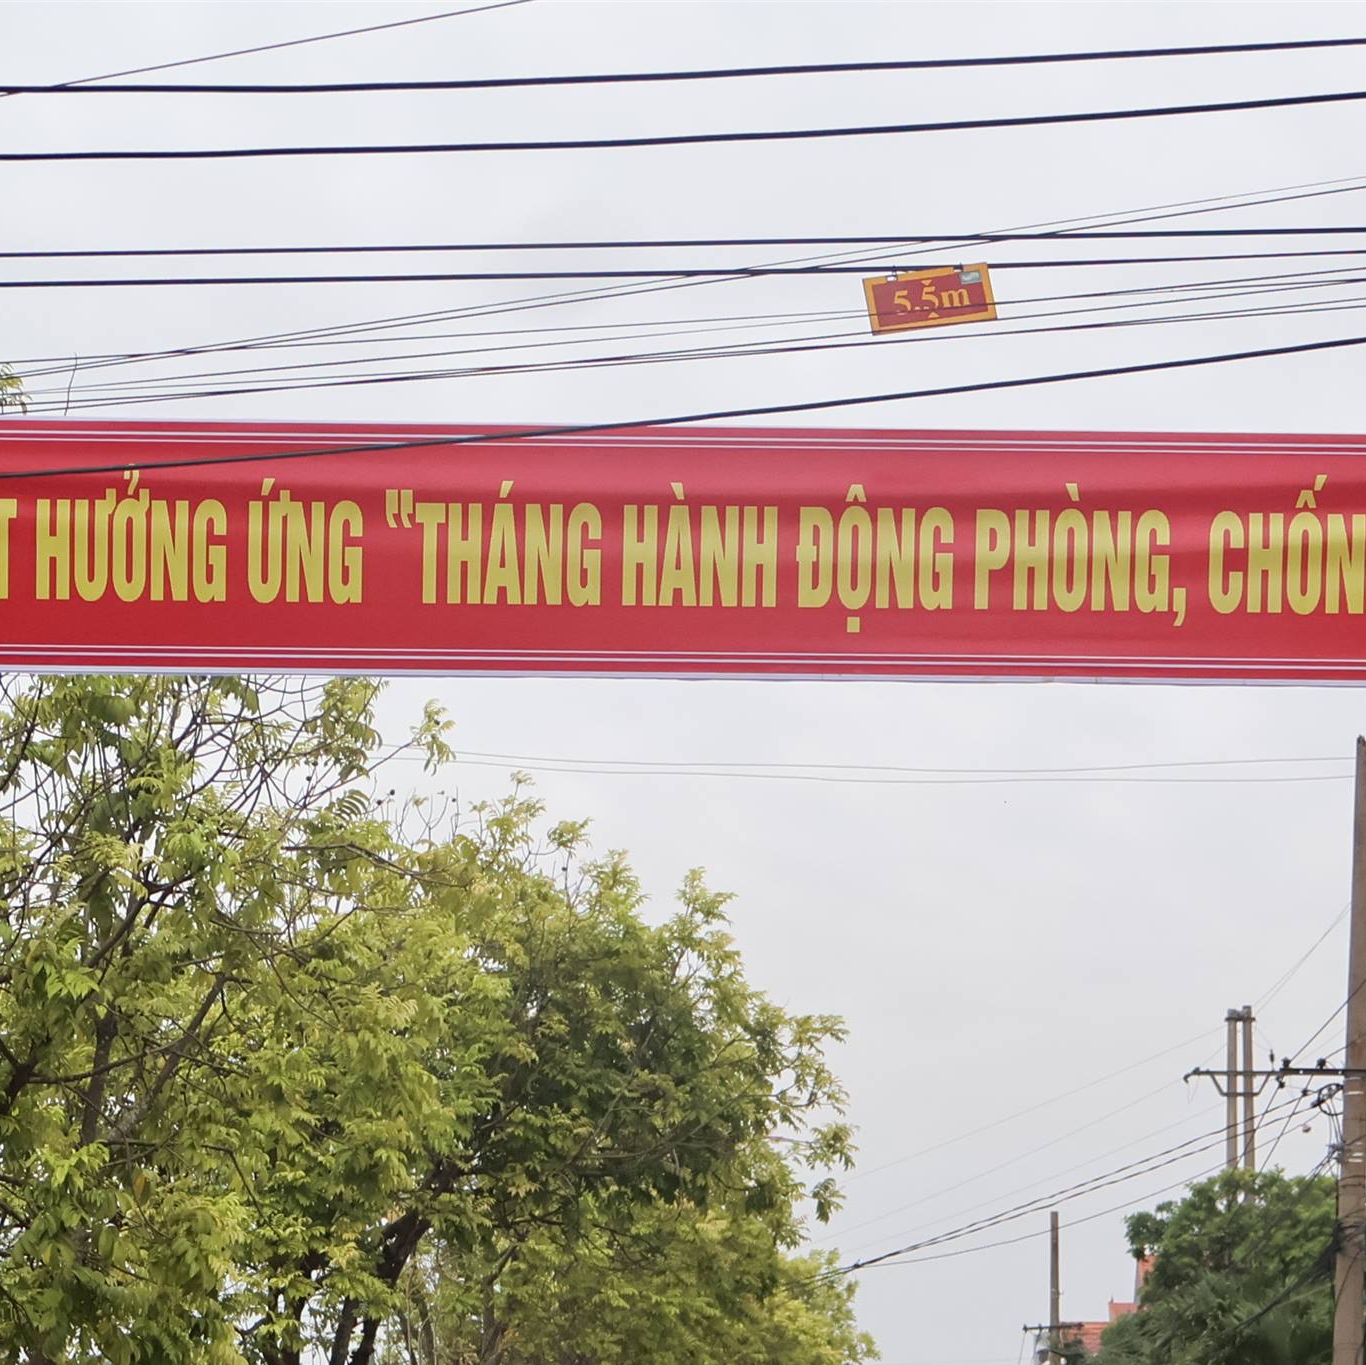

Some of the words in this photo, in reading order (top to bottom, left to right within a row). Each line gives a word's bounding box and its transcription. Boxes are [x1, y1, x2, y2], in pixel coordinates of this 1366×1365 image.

[893, 286, 972, 316] 5.5m
[35, 463, 228, 602] HƯỞNG
[247, 477, 364, 604] ỨNG
[622, 481, 778, 607] HÀNH
[797, 484, 954, 632] ĐỘNG
[974, 483, 1187, 626] PHÒNG,
